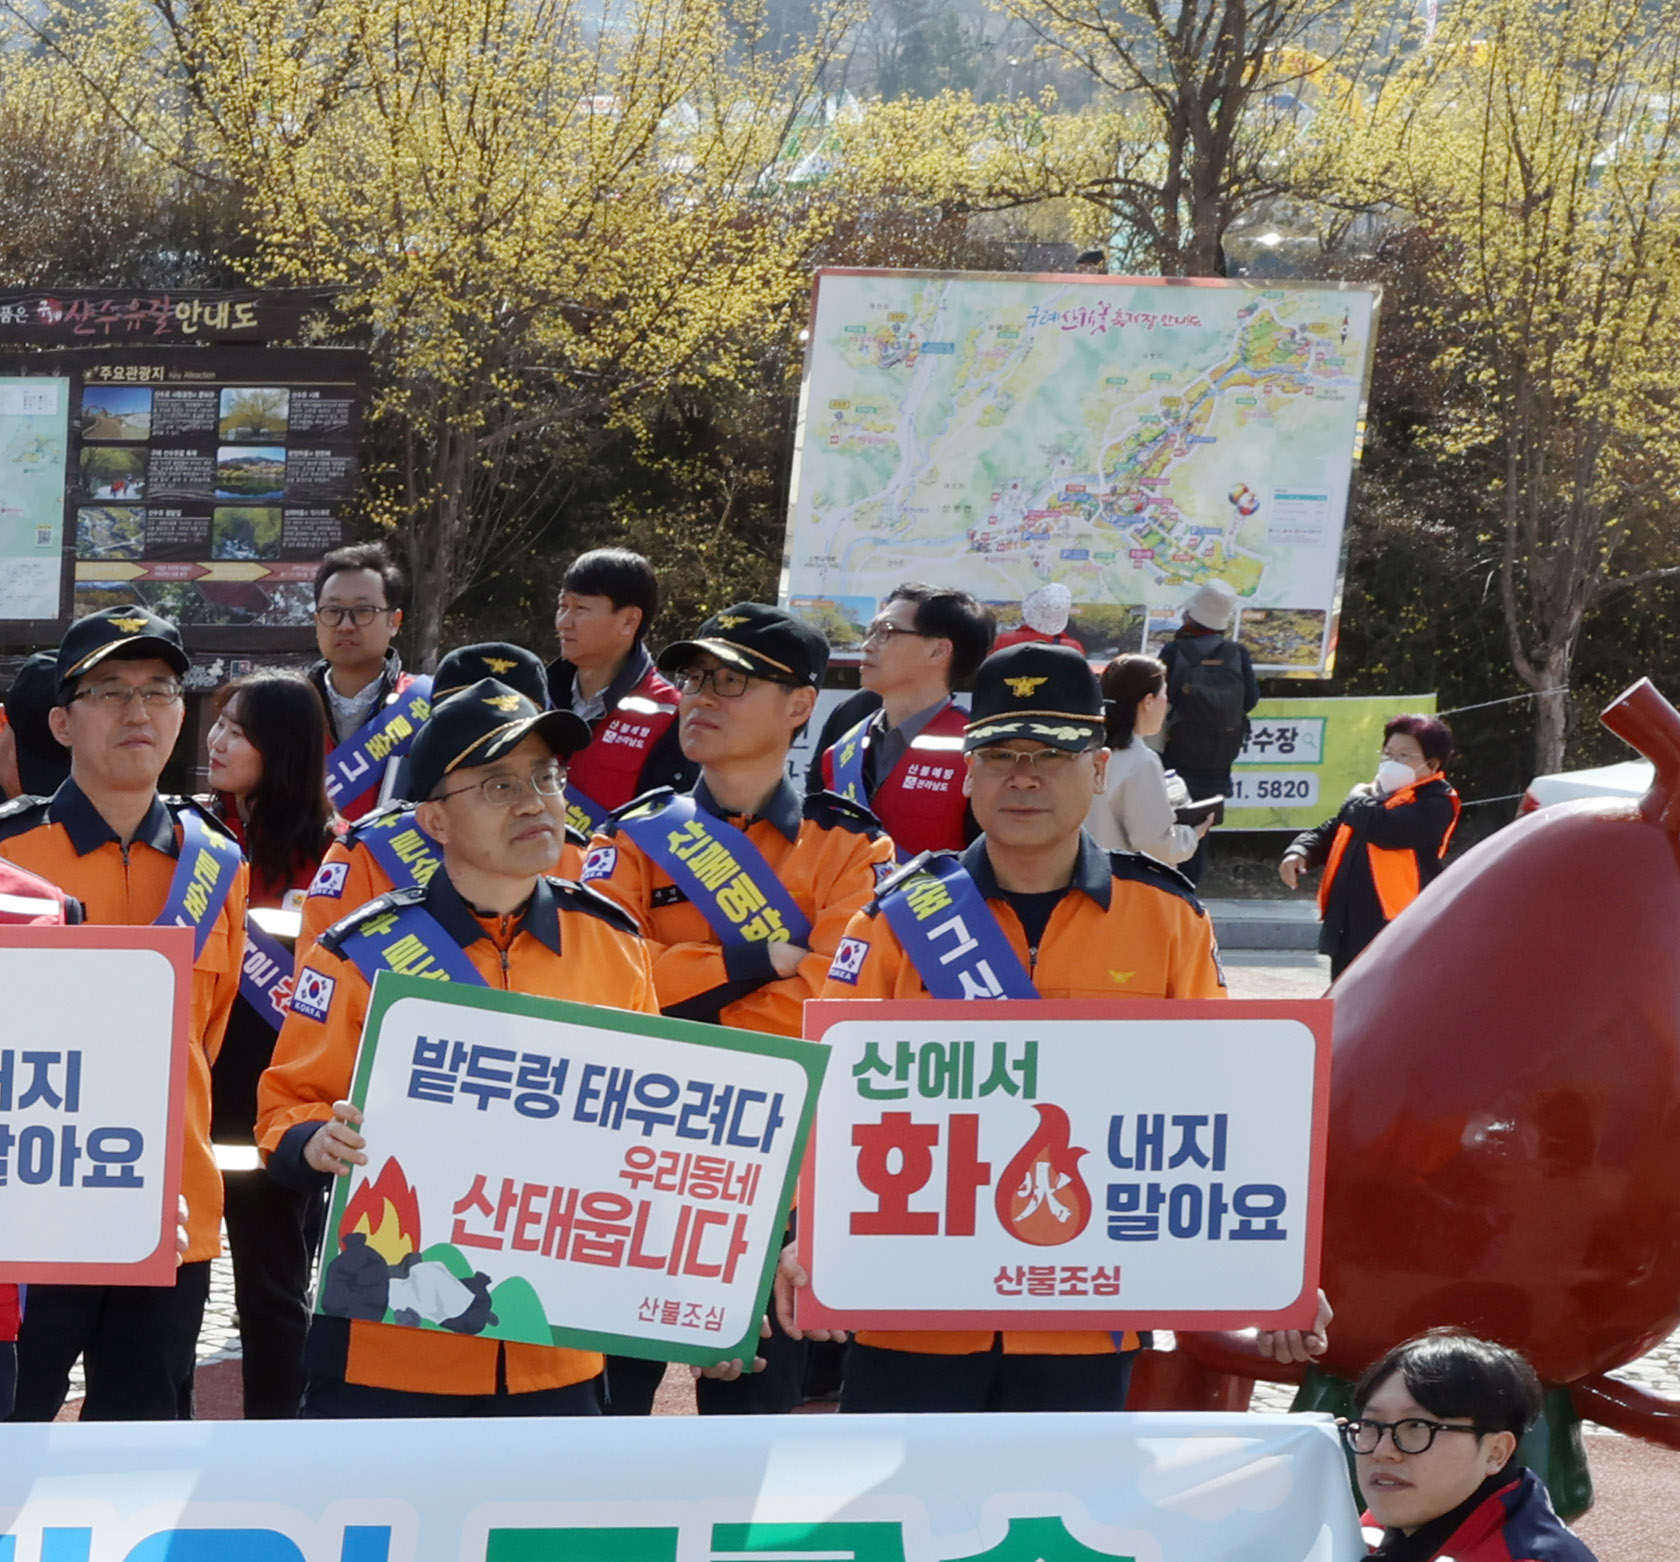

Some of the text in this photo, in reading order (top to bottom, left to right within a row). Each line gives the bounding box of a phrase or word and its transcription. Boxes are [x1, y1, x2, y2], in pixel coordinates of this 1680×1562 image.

[175, 299, 258, 334] 안내도
[99, 366, 164, 381] 주요관광지
[908, 763, 955, 780] 산불예방
[1257, 780, 1309, 799] 5820
[293, 1001, 322, 1019] KOREA
[851, 1040, 1040, 1101] 산에서
[406, 1034, 785, 1154] 밭두렁 태우려다
[618, 1145, 763, 1207] 우리동네
[848, 1111, 992, 1238] 화
[1106, 1113, 1229, 1173] 내지
[449, 1172, 750, 1285] 산태웁니다
[1105, 1182, 1289, 1243] 말아요
[992, 1265, 1122, 1297] 산불조심
[637, 1296, 727, 1332] 산불조심
